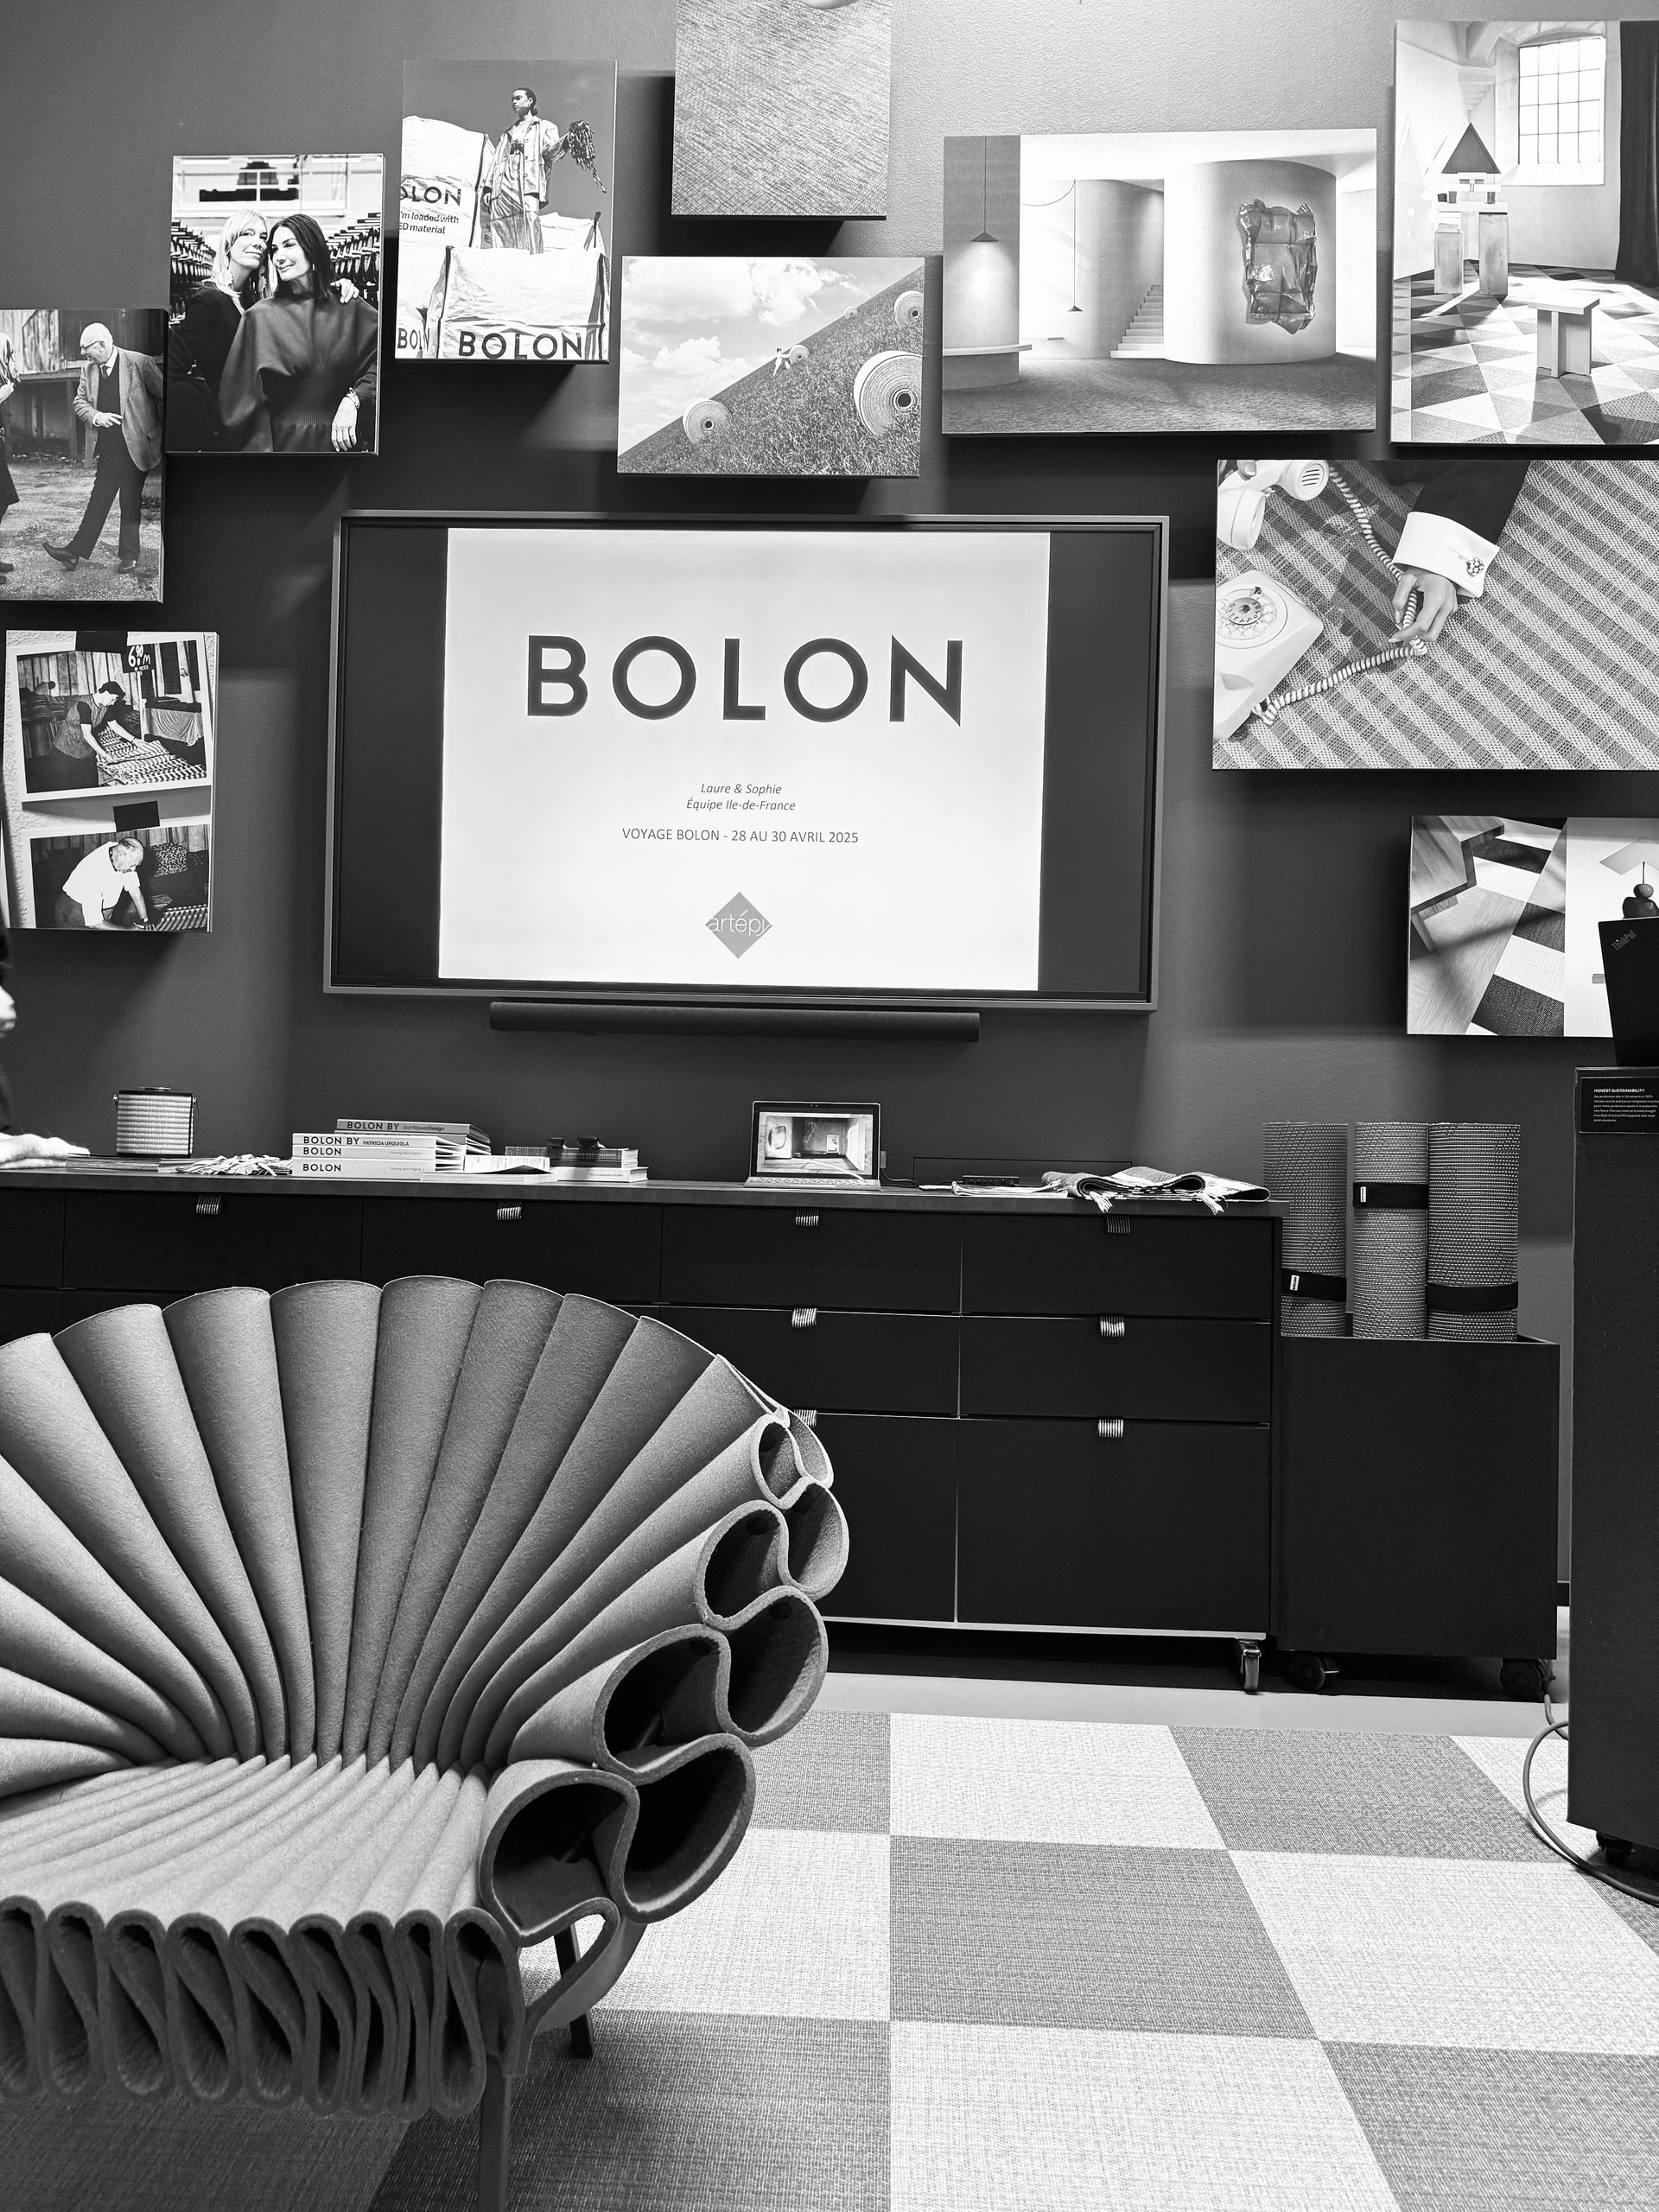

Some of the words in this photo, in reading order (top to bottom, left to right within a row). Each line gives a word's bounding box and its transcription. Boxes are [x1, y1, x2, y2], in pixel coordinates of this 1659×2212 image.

[411, 212, 439, 222] loaded
[440, 215, 459, 224] with
[410, 224, 446, 234] material
[459, 331, 582, 360] BOLON
[527, 633, 963, 728] BOLON
[701, 783, 731, 795] Laure
[734, 784, 743, 795] &
[746, 784, 782, 797] Sophie
[686, 797, 723, 811] Équipe
[726, 800, 796, 811] Ile-de-France
[622, 828, 673, 841] VOYAGE
[677, 830, 720, 841] BOLON
[732, 830, 747, 842] 28
[750, 830, 767, 842] AU
[772, 831, 786, 842] 30
[790, 831, 825, 843] AVRIL
[829, 832, 859, 843] 2025
[303, 1136, 342, 1145] BOLON
[302, 1163, 341, 1172] BOLON
